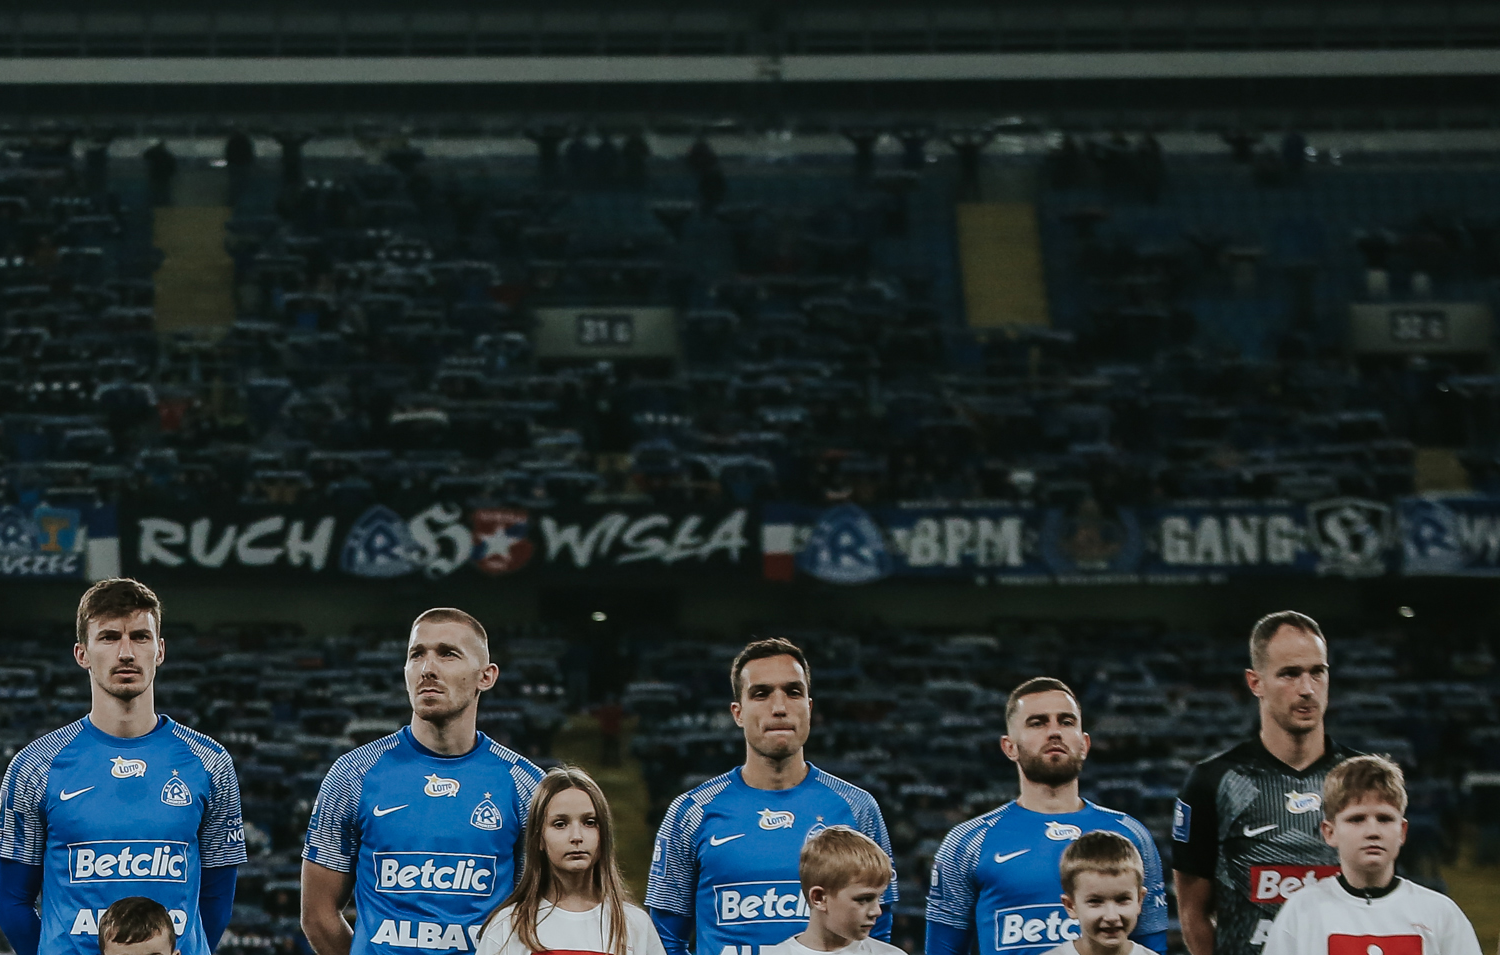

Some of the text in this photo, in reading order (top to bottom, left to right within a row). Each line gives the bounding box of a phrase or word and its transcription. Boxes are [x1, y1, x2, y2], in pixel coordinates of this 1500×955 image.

[138, 516, 336, 571] RUCH
[907, 514, 1303, 568] BPM GANG
[74, 846, 185, 878] Betclic
[380, 858, 491, 890] Betclic
[721, 887, 811, 920] Betcl
[370, 919, 468, 951] ALBA
[1002, 911, 1080, 944] Betc
